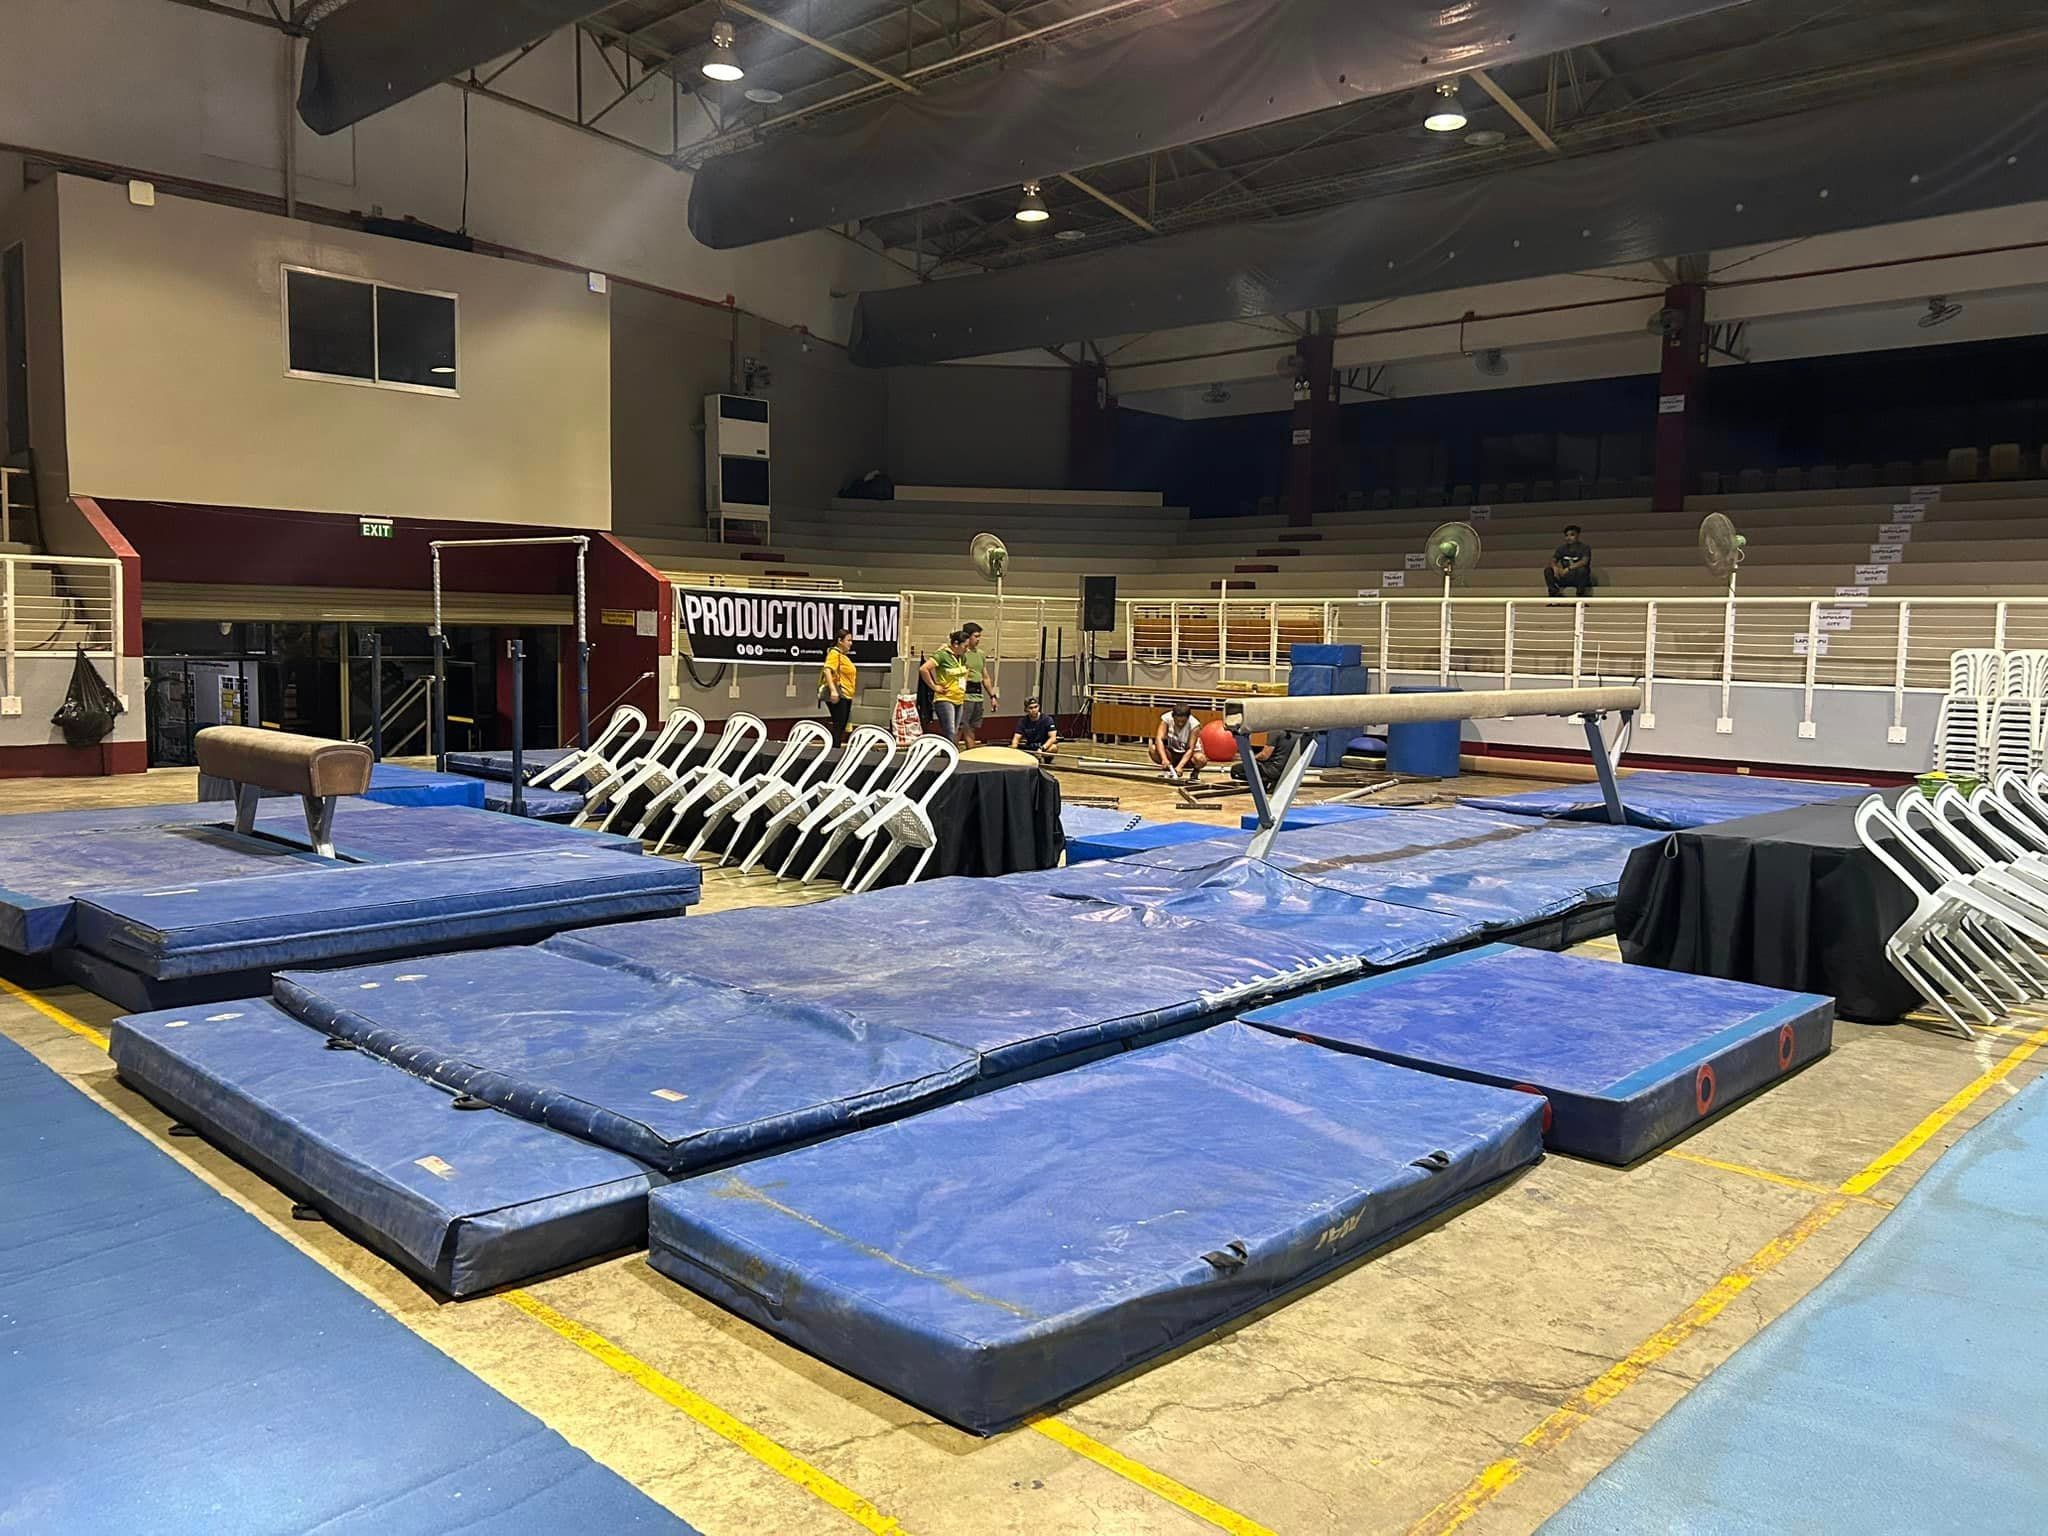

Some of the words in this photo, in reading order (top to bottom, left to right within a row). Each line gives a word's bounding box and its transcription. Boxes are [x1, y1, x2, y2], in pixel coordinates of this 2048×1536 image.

[363, 524, 390, 536] EXIT
[685, 594, 834, 640] PRODUCTION
[839, 603, 898, 642] TEAM
